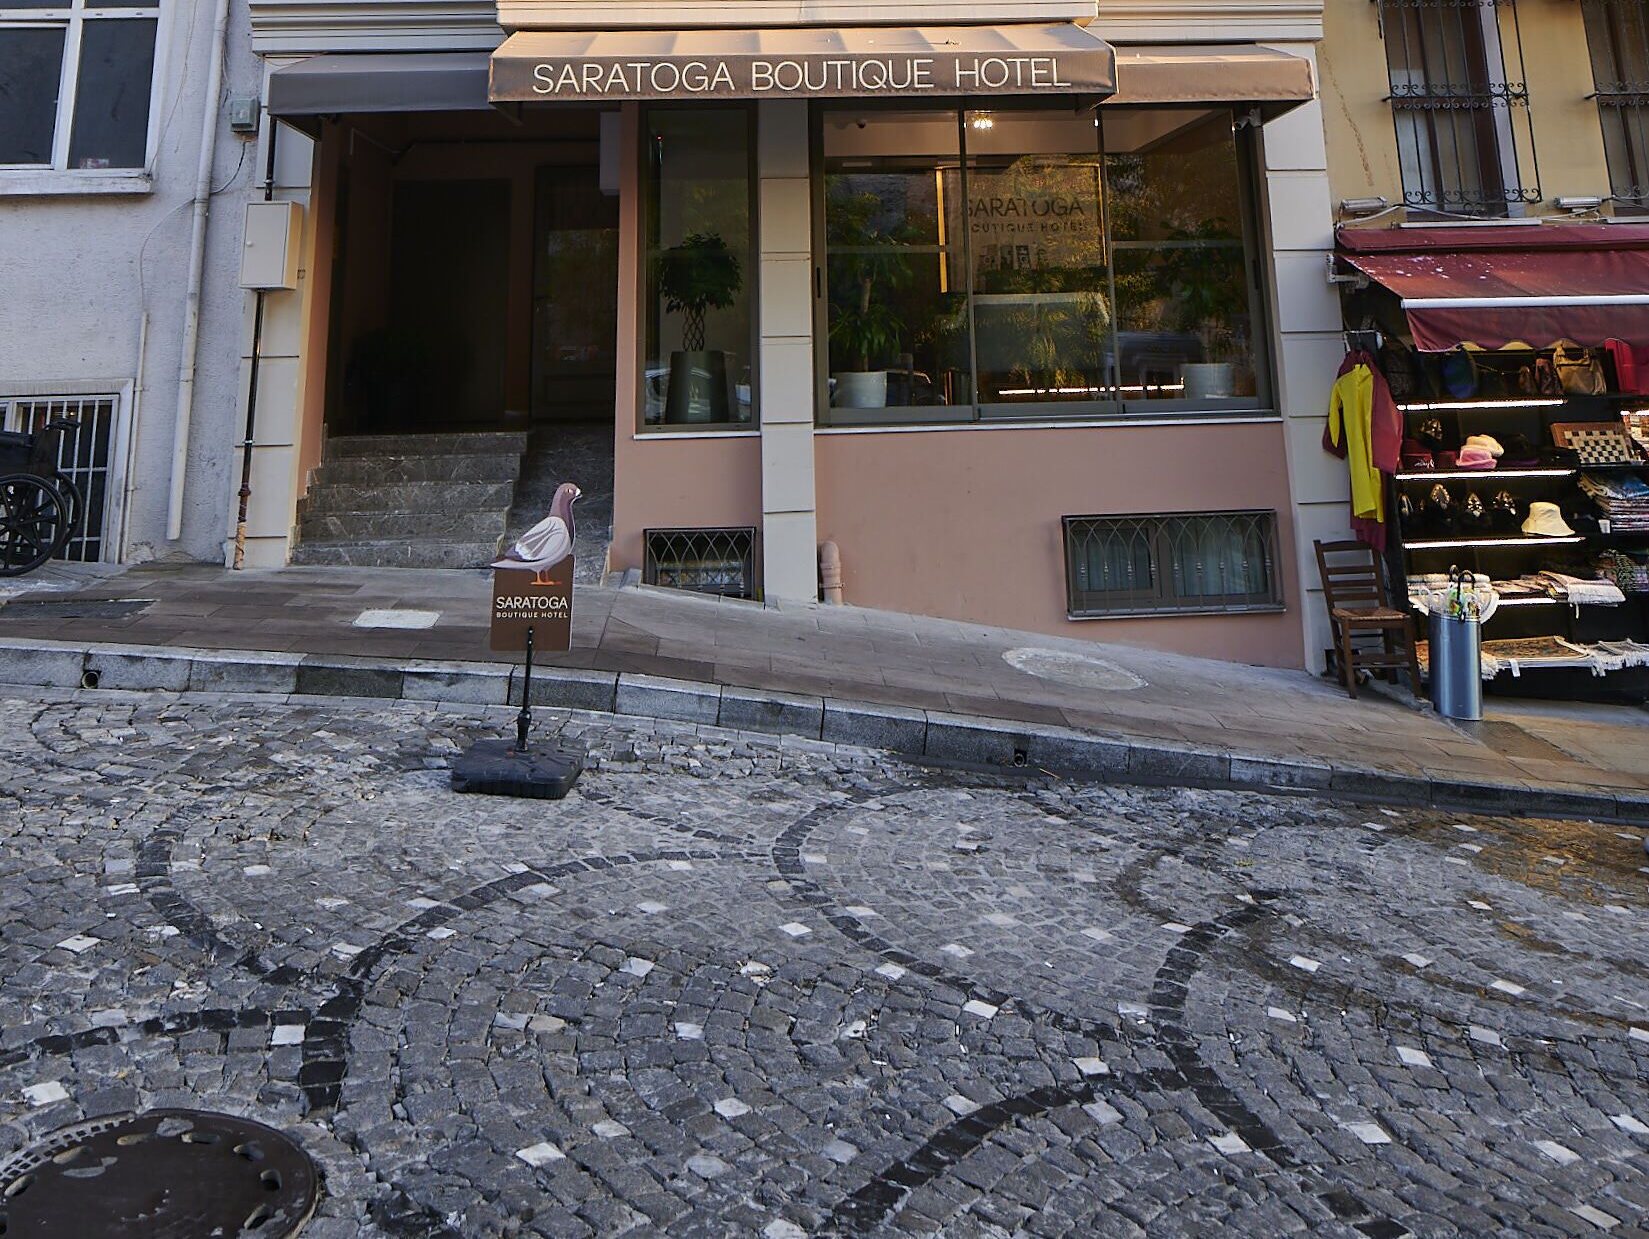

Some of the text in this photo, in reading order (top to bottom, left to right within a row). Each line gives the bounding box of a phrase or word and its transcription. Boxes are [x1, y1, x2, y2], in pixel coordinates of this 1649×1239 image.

[532, 57, 1073, 95] SARATOGA BOUTIQUE HOTEL
[970, 222, 1035, 234] OUTIQUE
[496, 596, 568, 610] SARATOGA
[496, 611, 568, 619] BOUTIQUE HOTEL
